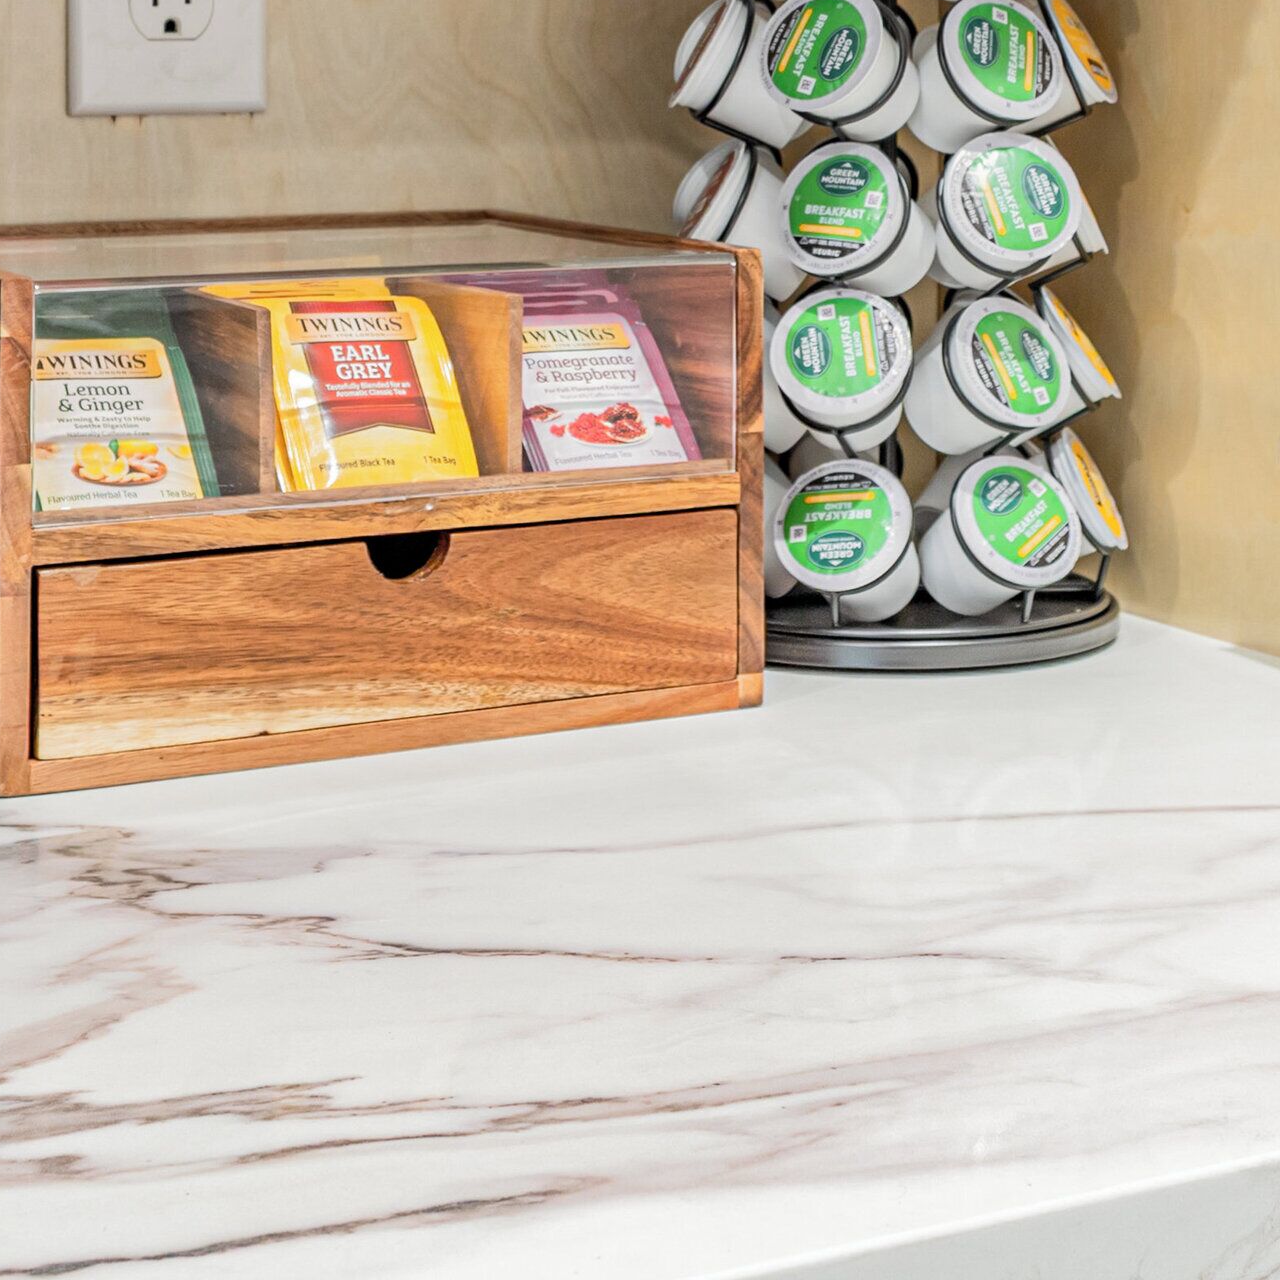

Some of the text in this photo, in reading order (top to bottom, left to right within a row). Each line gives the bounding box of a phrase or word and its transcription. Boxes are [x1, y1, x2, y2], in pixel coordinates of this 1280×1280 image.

[793, 13, 829, 78] BREAKFAST
[973, 26, 981, 55] GREEN
[980, 21, 990, 65] MOUNTAIN
[822, 29, 849, 76] MOUNTAIN
[833, 38, 853, 70] GREEN
[1007, 23, 1019, 84] BREAKFAST
[820, 175, 866, 186] MOUNTAIN
[829, 168, 860, 177] GREEN
[993, 166, 1026, 230] BREAKFAST
[1028, 167, 1052, 215] MOUNTAIN
[1039, 173, 1058, 206] GREEN
[804, 204, 866, 219] BREAKFAST
[818, 216, 845, 225] BLEND
[296, 316, 402, 333] TWININGS
[330, 344, 390, 362] EARL
[801, 336, 812, 368] GREEN
[807, 327, 822, 374] MOUNTAIN
[838, 316, 857, 377] BREAKFAST
[336, 362, 392, 380] GREY
[524, 355, 635, 370] Pomegranate
[995, 330, 1032, 395] BREAKFAST
[536, 368, 637, 384] & Raspberry
[63, 383, 131, 397] Lemon
[58, 397, 144, 414] & Ginger
[360, 459, 380, 468] Black
[382, 457, 396, 466] Tea
[429, 456, 441, 464] Tea
[442, 456, 457, 466] Bag
[47, 490, 138, 504] Flavoured Herbal Tea
[166, 489, 180, 498] Tea
[804, 509, 873, 523] BREAKFAST
[1004, 500, 1048, 543] BREAKFAST
[811, 541, 862, 553] MOUNTAIN
[820, 550, 854, 560] GREEN
